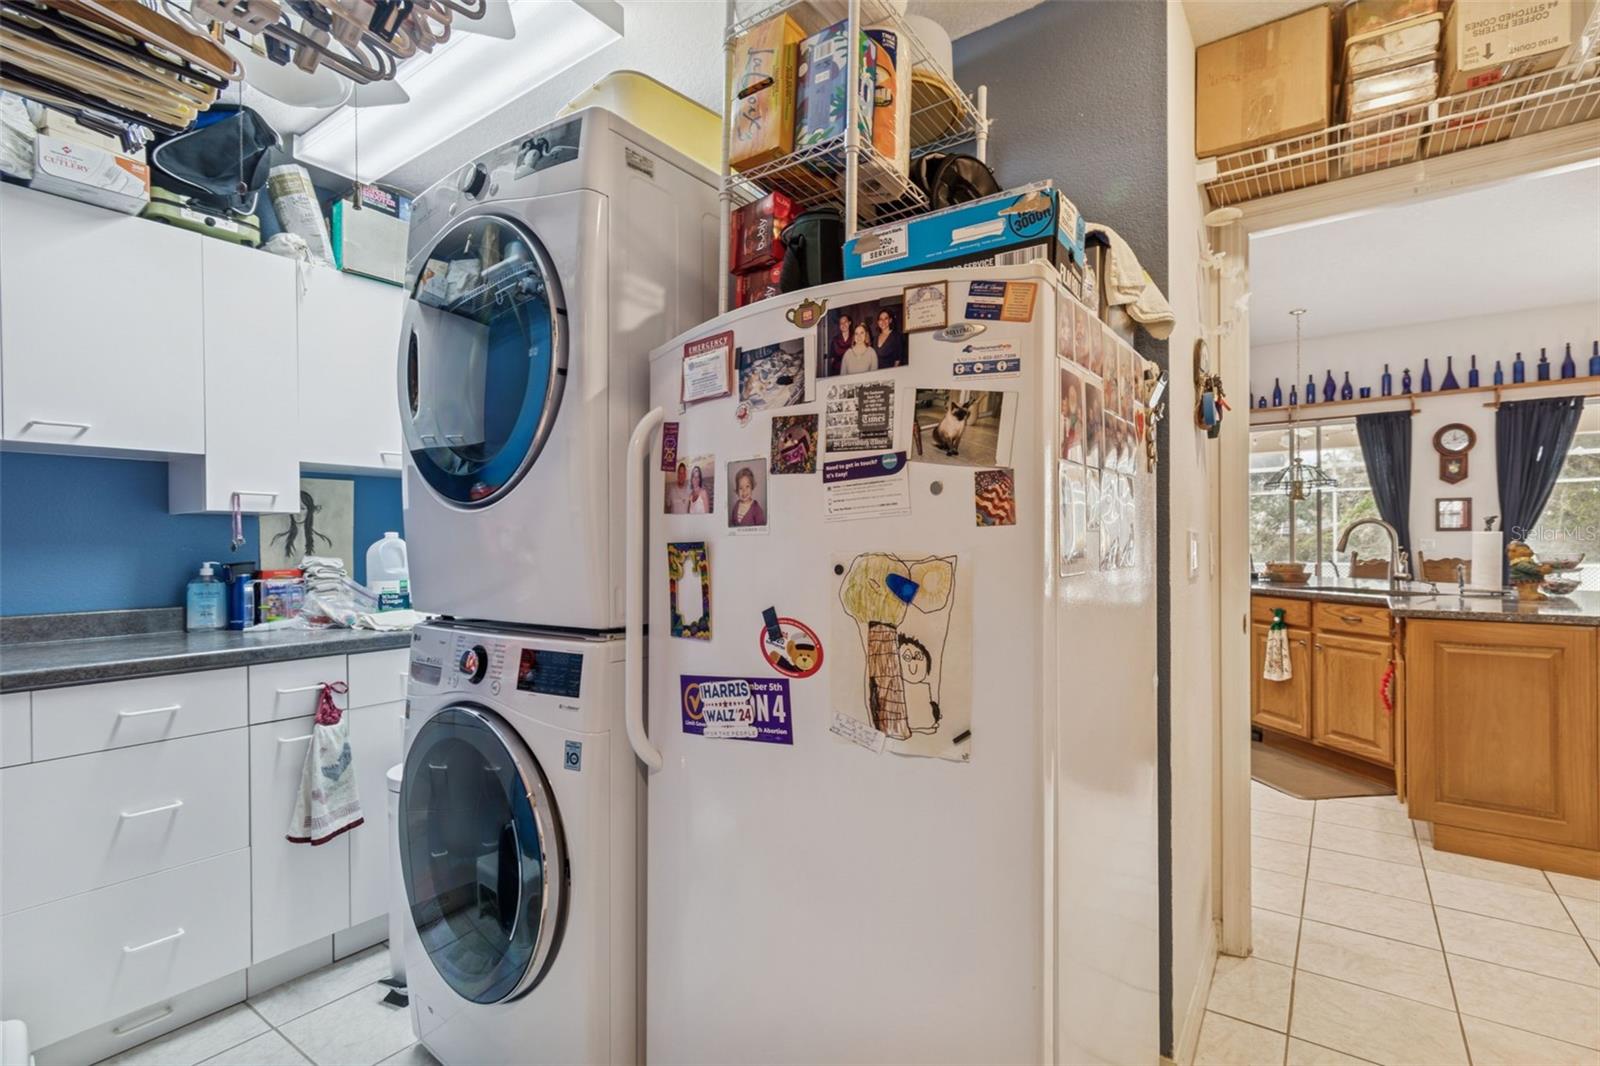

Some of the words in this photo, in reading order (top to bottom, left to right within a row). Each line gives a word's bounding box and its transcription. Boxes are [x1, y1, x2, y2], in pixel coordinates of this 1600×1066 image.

[1547, 0, 1559, 10] #4
[1498, 3, 1546, 22] STITCHED
[1511, 11, 1550, 28] COFFEE
[1464, 18, 1497, 32] CONES
[1472, 22, 1509, 38] FILTERS
[1509, 41, 1537, 55] COUNT
[43, 154, 89, 174] CUTLERY
[756, 217, 768, 252] bubly
[869, 246, 899, 260] SERVICE
[688, 336, 728, 354] EMERGENCY
[845, 462, 854, 470] get
[860, 458, 878, 466] touch?
[835, 471, 848, 479] Easy!
[703, 681, 749, 699] HARRIS
[768, 683, 783, 692] 5th
[706, 708, 736, 722] WALZ
[736, 708, 752, 721] '24
[772, 694, 786, 724] 4
[761, 727, 788, 735] Abortion
